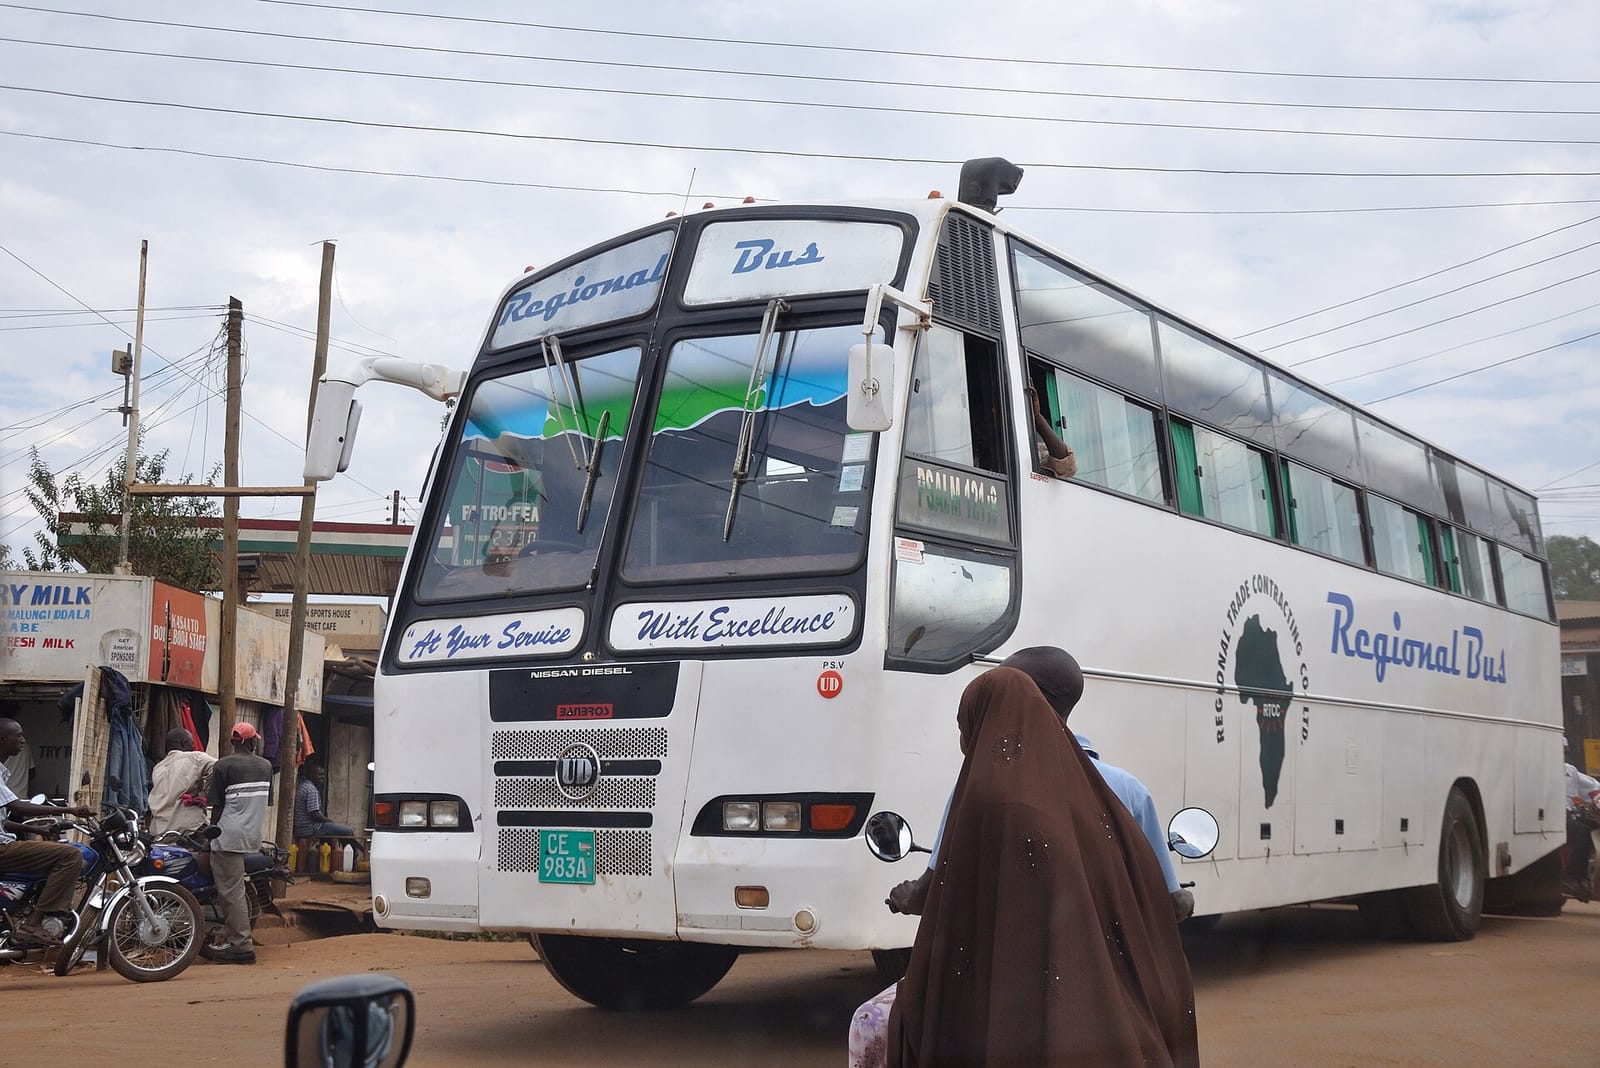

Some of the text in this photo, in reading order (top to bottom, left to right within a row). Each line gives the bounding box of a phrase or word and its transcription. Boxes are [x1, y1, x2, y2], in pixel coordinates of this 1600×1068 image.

[500, 239, 825, 326] Regional Bus
[31, 584, 92, 606] MILK
[53, 608, 91, 620] DDALA
[275, 608, 290, 618] BLUE
[310, 609, 332, 618] SPORTS
[332, 609, 352, 619] HOUSE
[322, 622, 337, 631] CAFE
[637, 609, 704, 641] With
[42, 638, 75, 649] MILK
[446, 624, 493, 658] Your
[497, 620, 571, 649] Service
[1327, 591, 1507, 684] Regional Bus
[1215, 629, 1231, 744] REGIONAL
[1227, 580, 1251, 627] TRADE
[1252, 574, 1303, 657] CONTRACTING
[530, 667, 633, 679] NISSAN DIESEL
[820, 677, 840, 691] UD
[561, 757, 595, 786] UD
[547, 833, 570, 855] CE
[544, 856, 588, 879] 983A
